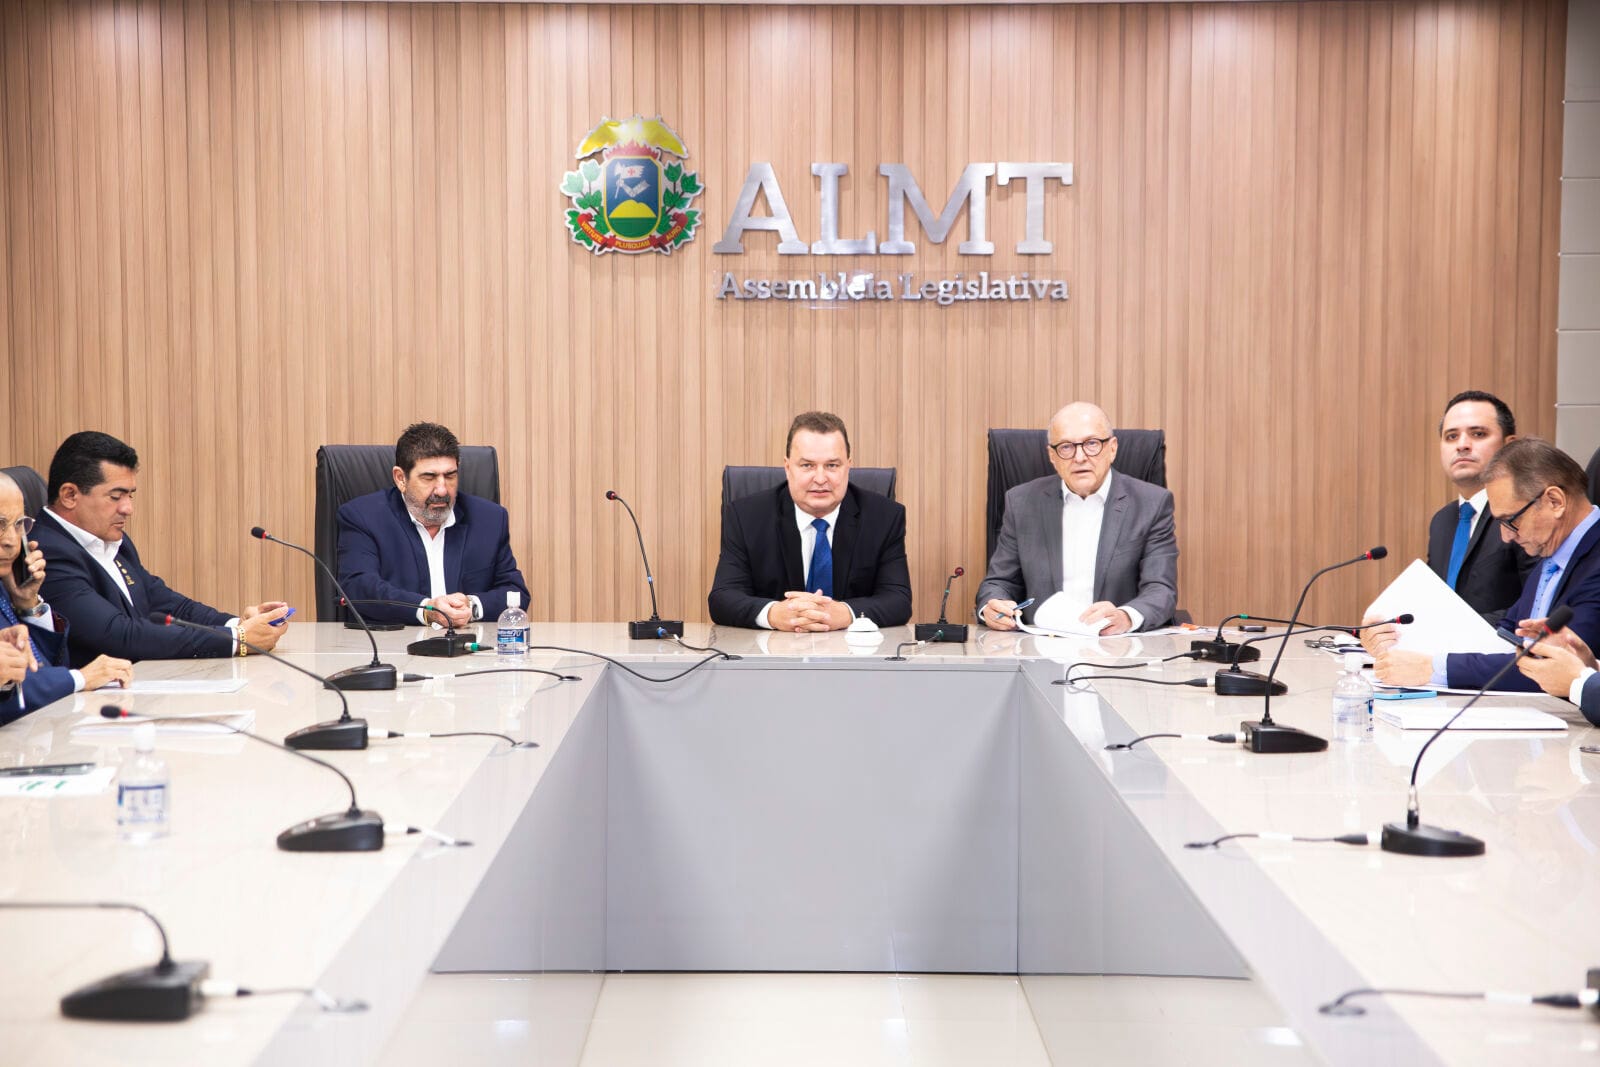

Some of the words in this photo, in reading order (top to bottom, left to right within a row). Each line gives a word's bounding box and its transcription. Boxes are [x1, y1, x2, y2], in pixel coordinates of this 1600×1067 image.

[713, 162, 1073, 254] ALMT
[717, 271, 894, 300] Assembleia
[901, 271, 1069, 305] Legislativa
